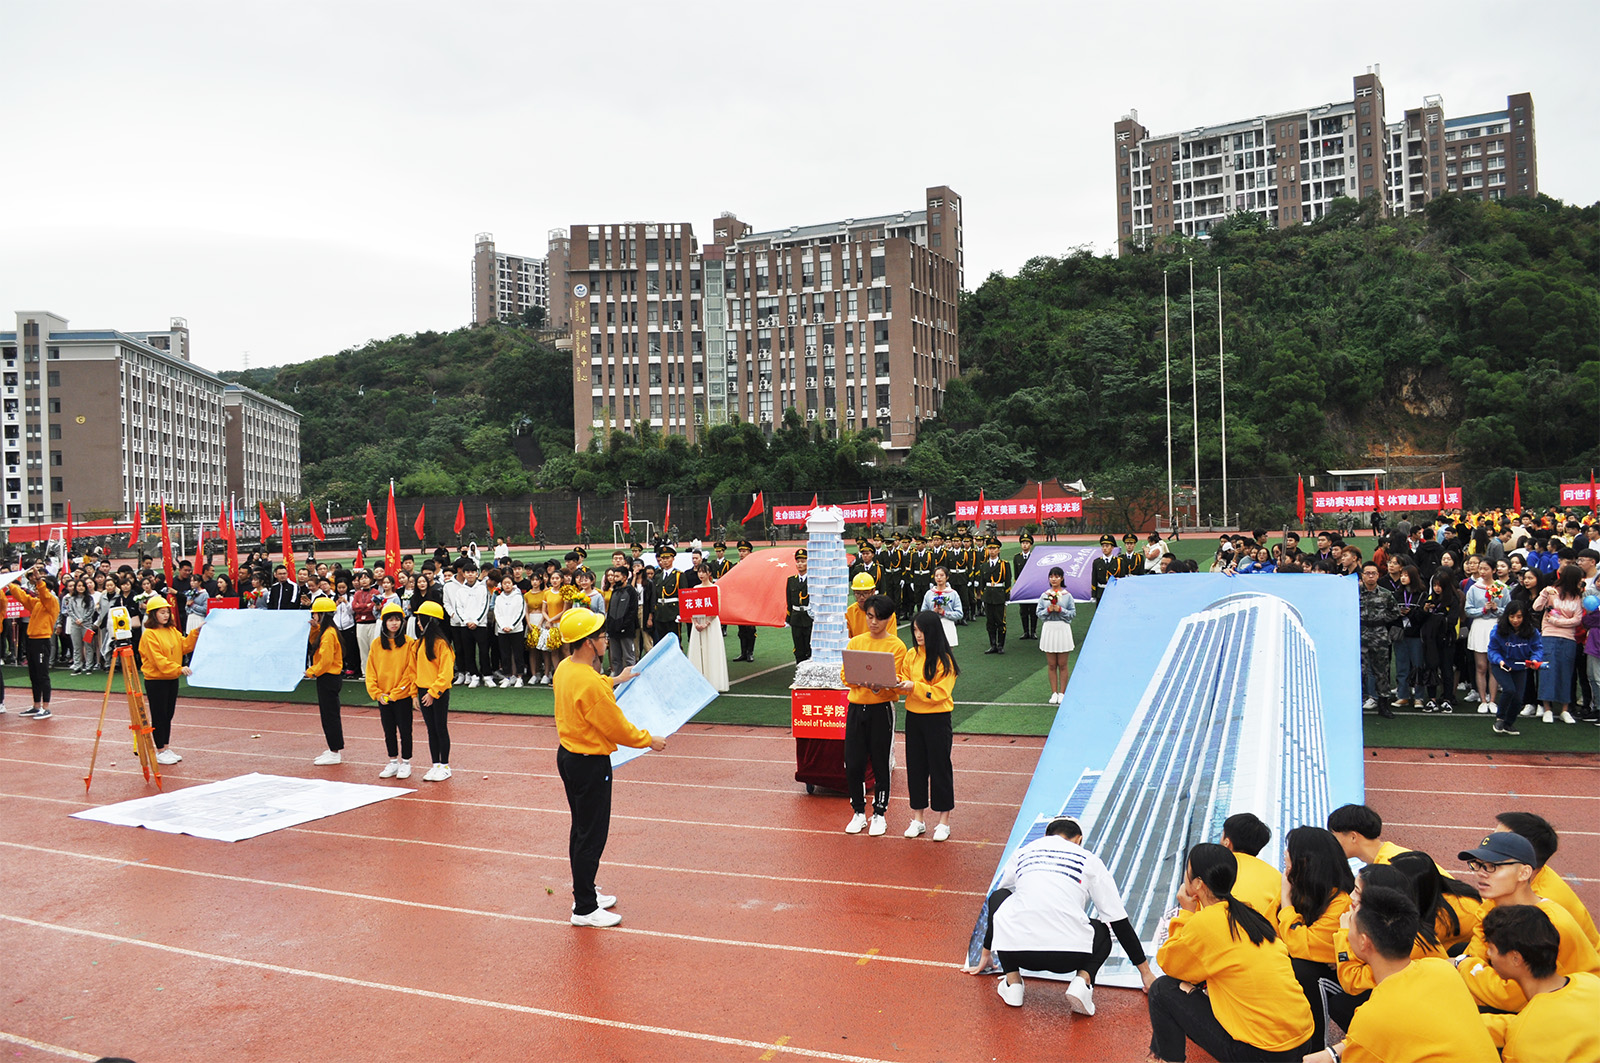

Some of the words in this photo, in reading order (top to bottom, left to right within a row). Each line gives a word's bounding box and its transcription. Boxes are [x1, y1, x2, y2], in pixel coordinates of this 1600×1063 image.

[685, 597, 713, 609] 花束队
[801, 704, 846, 717] 理工学院
[793, 718, 813, 727] School
[812, 719, 819, 727] of
